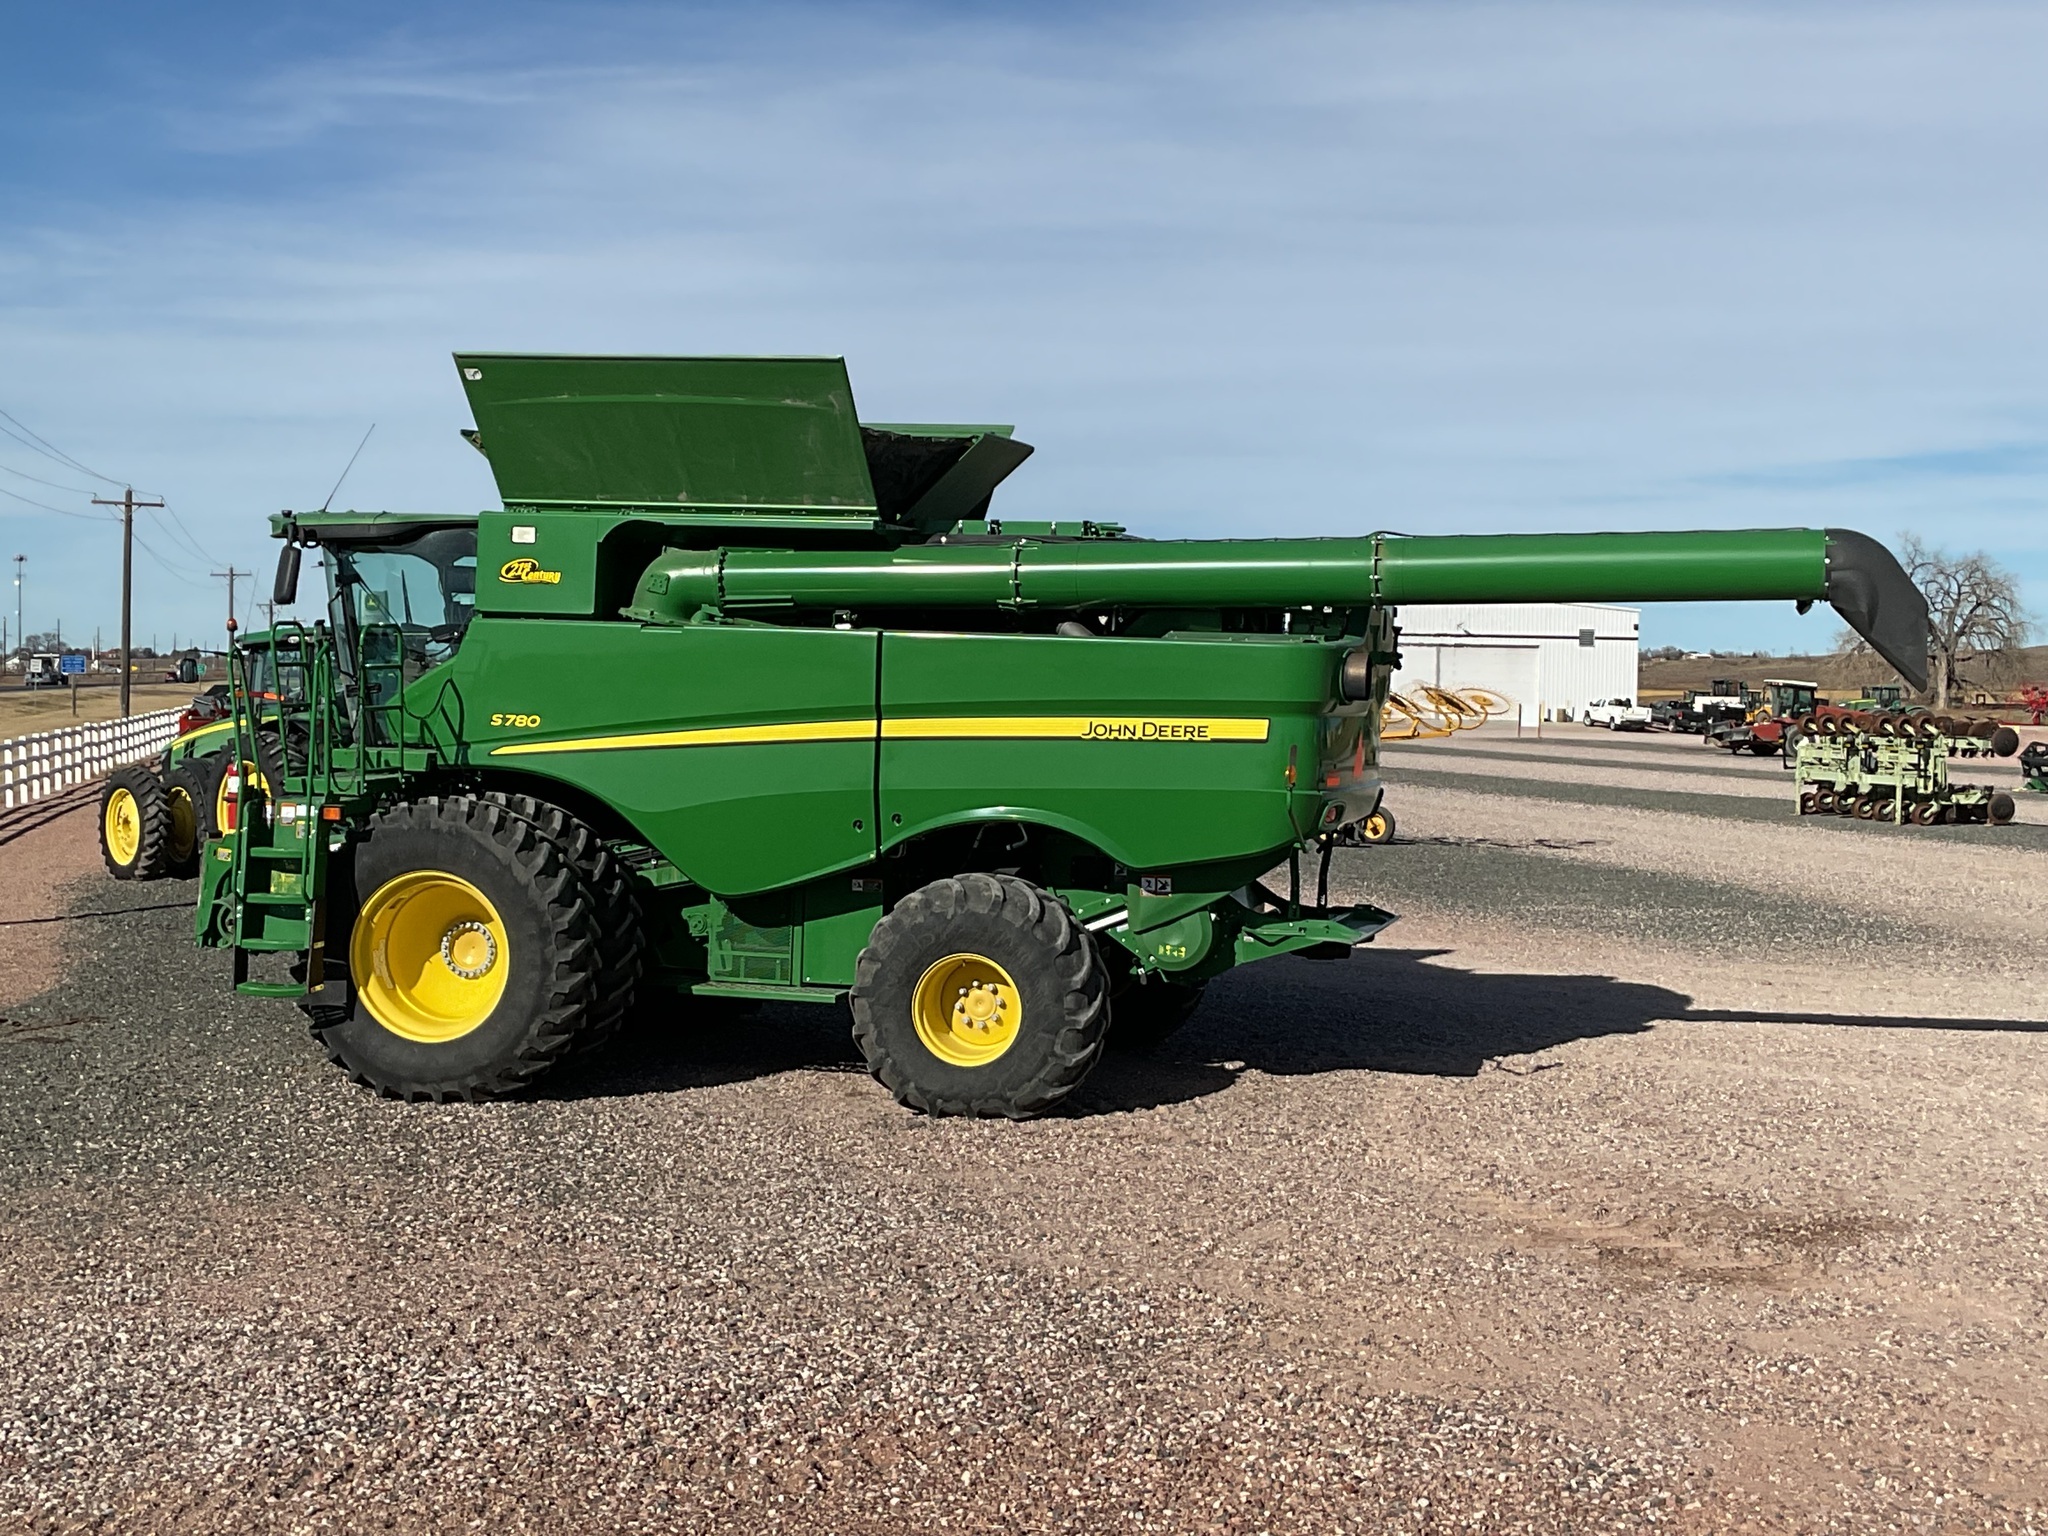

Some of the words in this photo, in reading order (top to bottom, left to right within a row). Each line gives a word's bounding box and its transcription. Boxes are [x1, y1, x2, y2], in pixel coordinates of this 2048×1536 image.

[490, 713, 541, 728] S780
[1081, 720, 1136, 737] JOHN
[1142, 721, 1209, 738] DEERE
